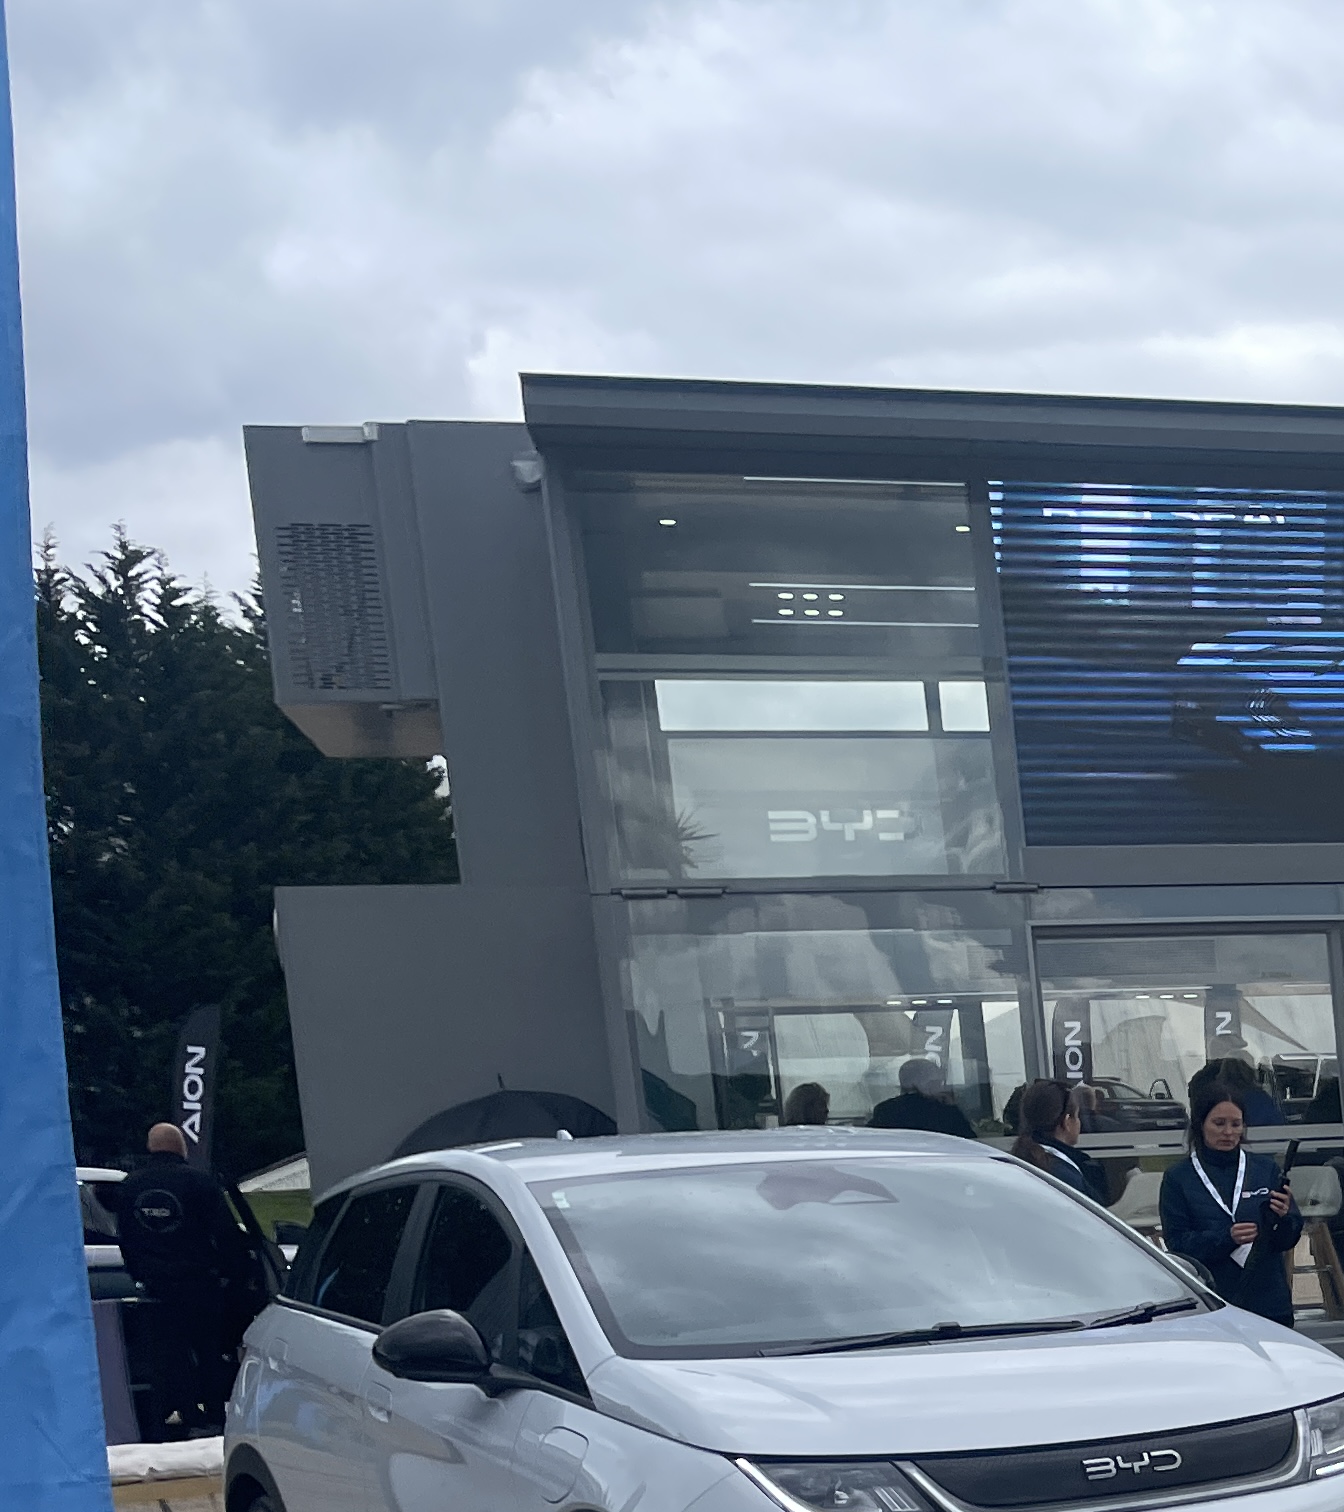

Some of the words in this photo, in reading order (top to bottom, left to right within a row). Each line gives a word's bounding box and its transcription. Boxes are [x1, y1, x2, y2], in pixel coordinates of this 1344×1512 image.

[1063, 1021, 1084, 1083] ION
[182, 1044, 206, 1144] AION
[1082, 1449, 1183, 1481] BYD
